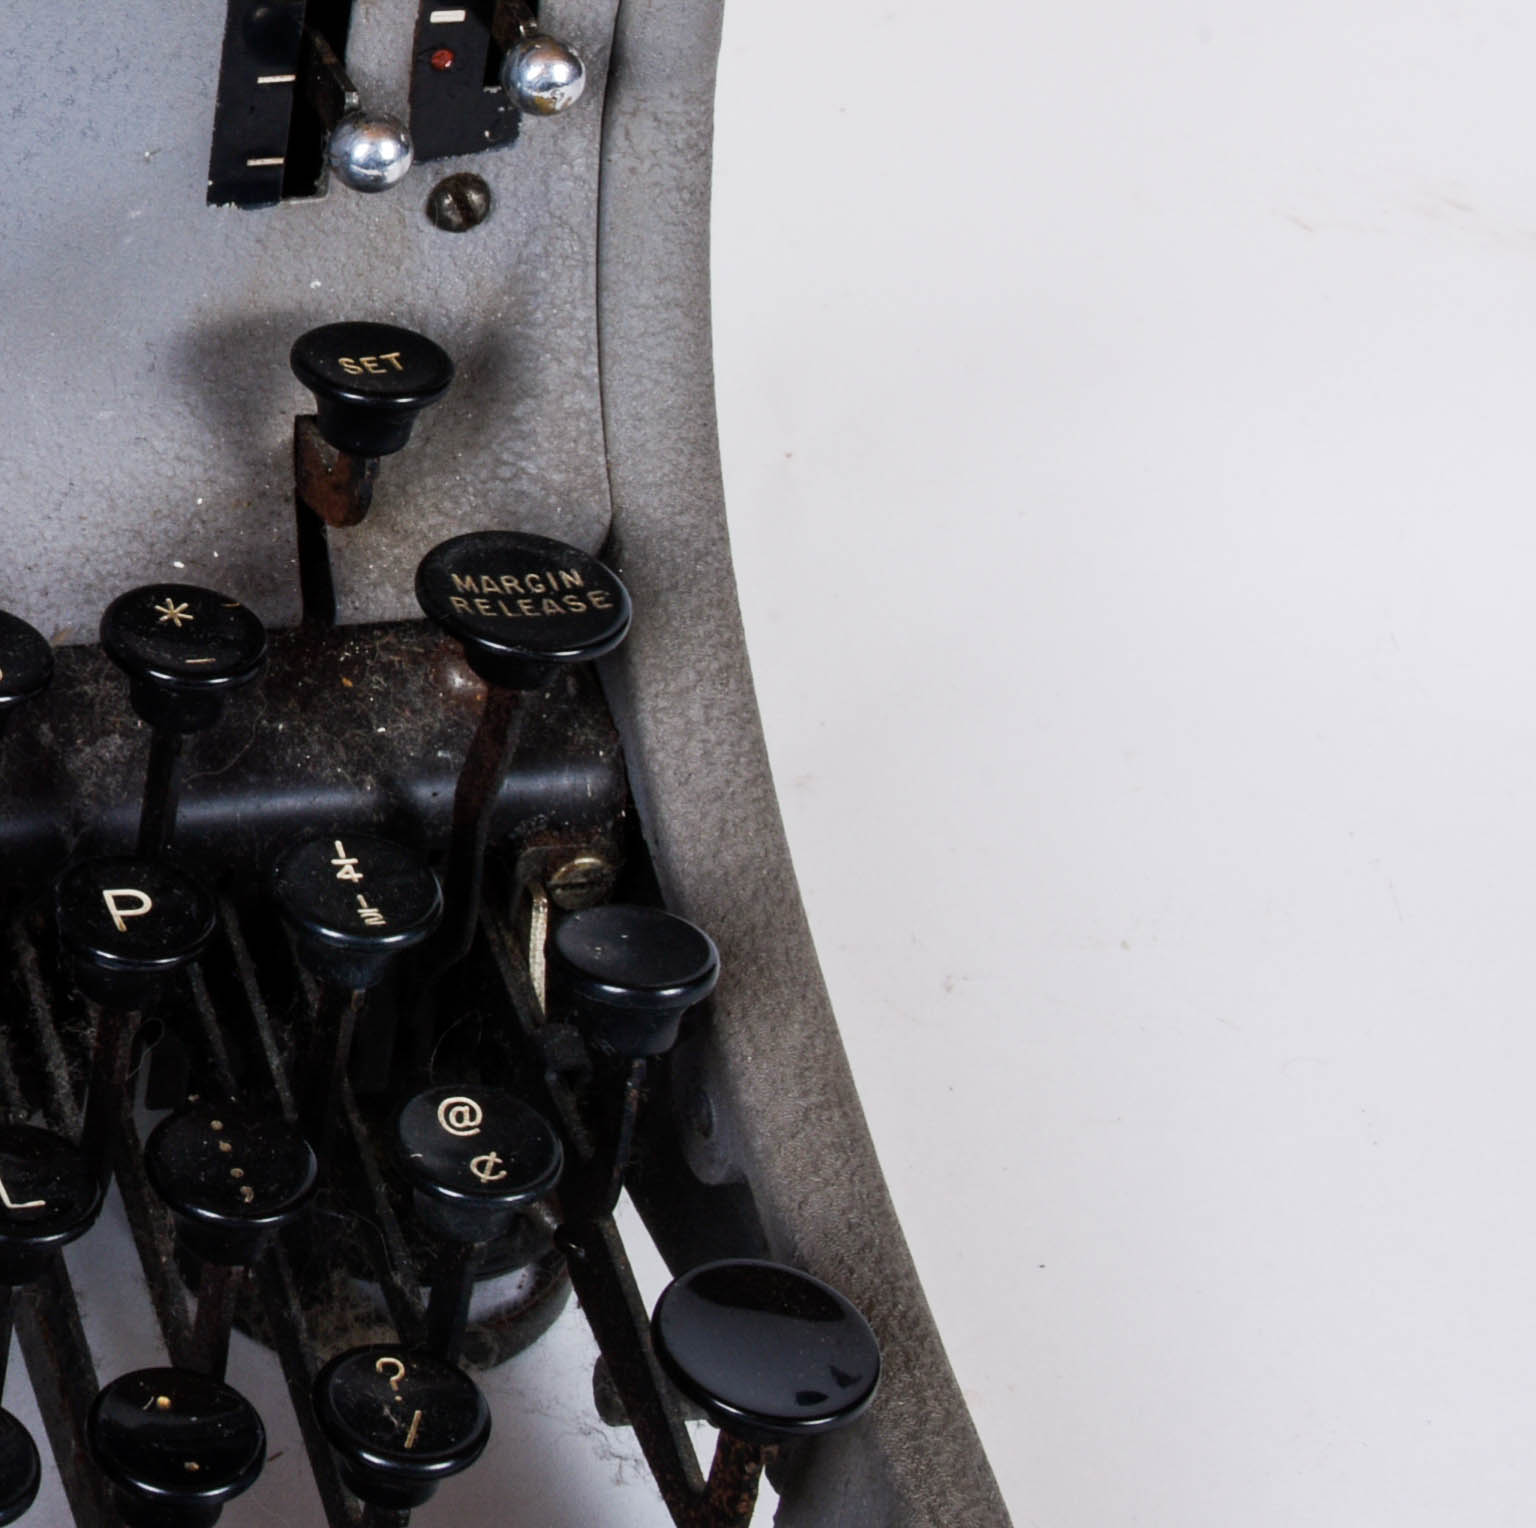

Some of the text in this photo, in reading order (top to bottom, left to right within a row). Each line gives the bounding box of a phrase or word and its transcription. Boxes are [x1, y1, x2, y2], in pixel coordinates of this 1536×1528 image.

[338, 351, 403, 375] SET
[450, 568, 584, 596] MARGIN
[449, 589, 613, 618] RELEASE
[102, 888, 153, 932] P
[437, 1096, 483, 1137] @
[375, 1357, 406, 1404] ?
